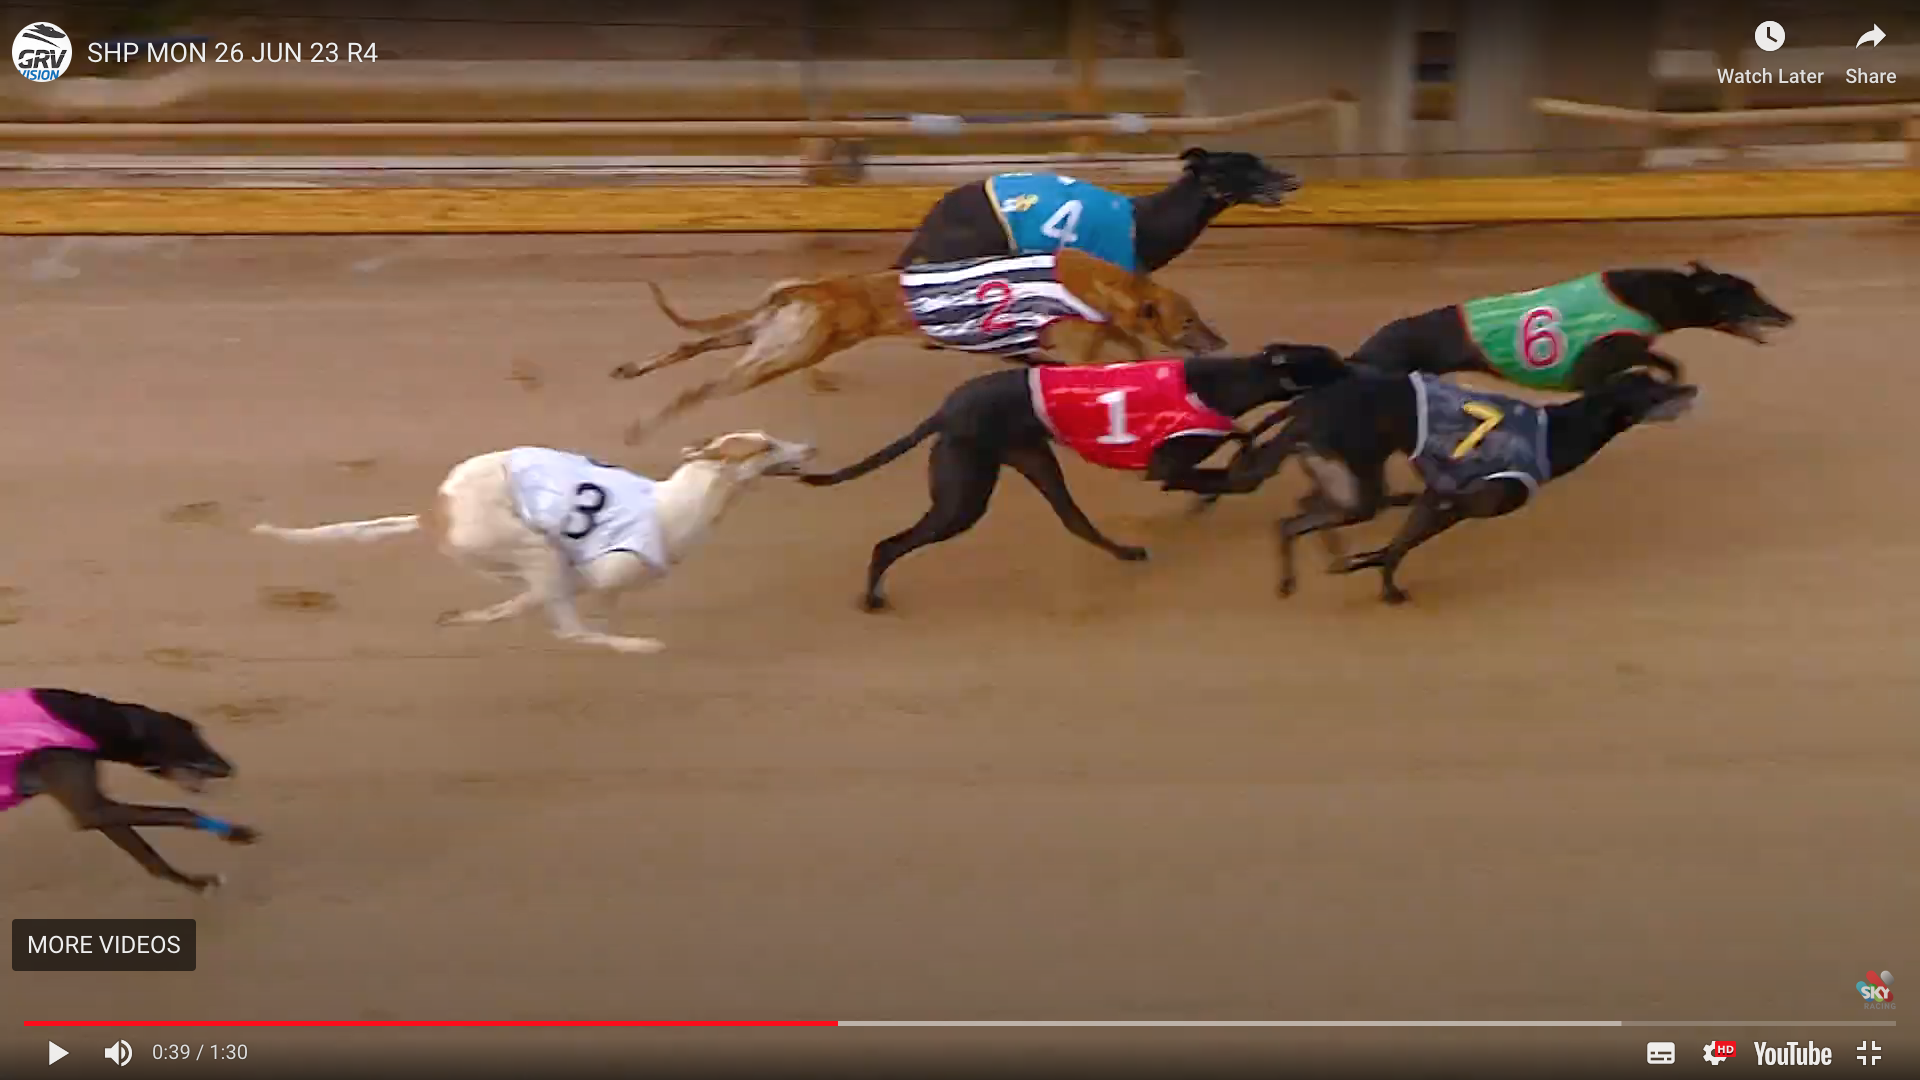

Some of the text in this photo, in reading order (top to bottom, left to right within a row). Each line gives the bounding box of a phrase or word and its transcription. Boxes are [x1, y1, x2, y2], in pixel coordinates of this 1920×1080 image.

[1042, 199, 1082, 248] 4
[976, 279, 1016, 332] 2
[1515, 306, 1570, 370] 6
[1096, 390, 1136, 445] 1
[1452, 402, 1505, 460] 7
[560, 482, 606, 540] 3
